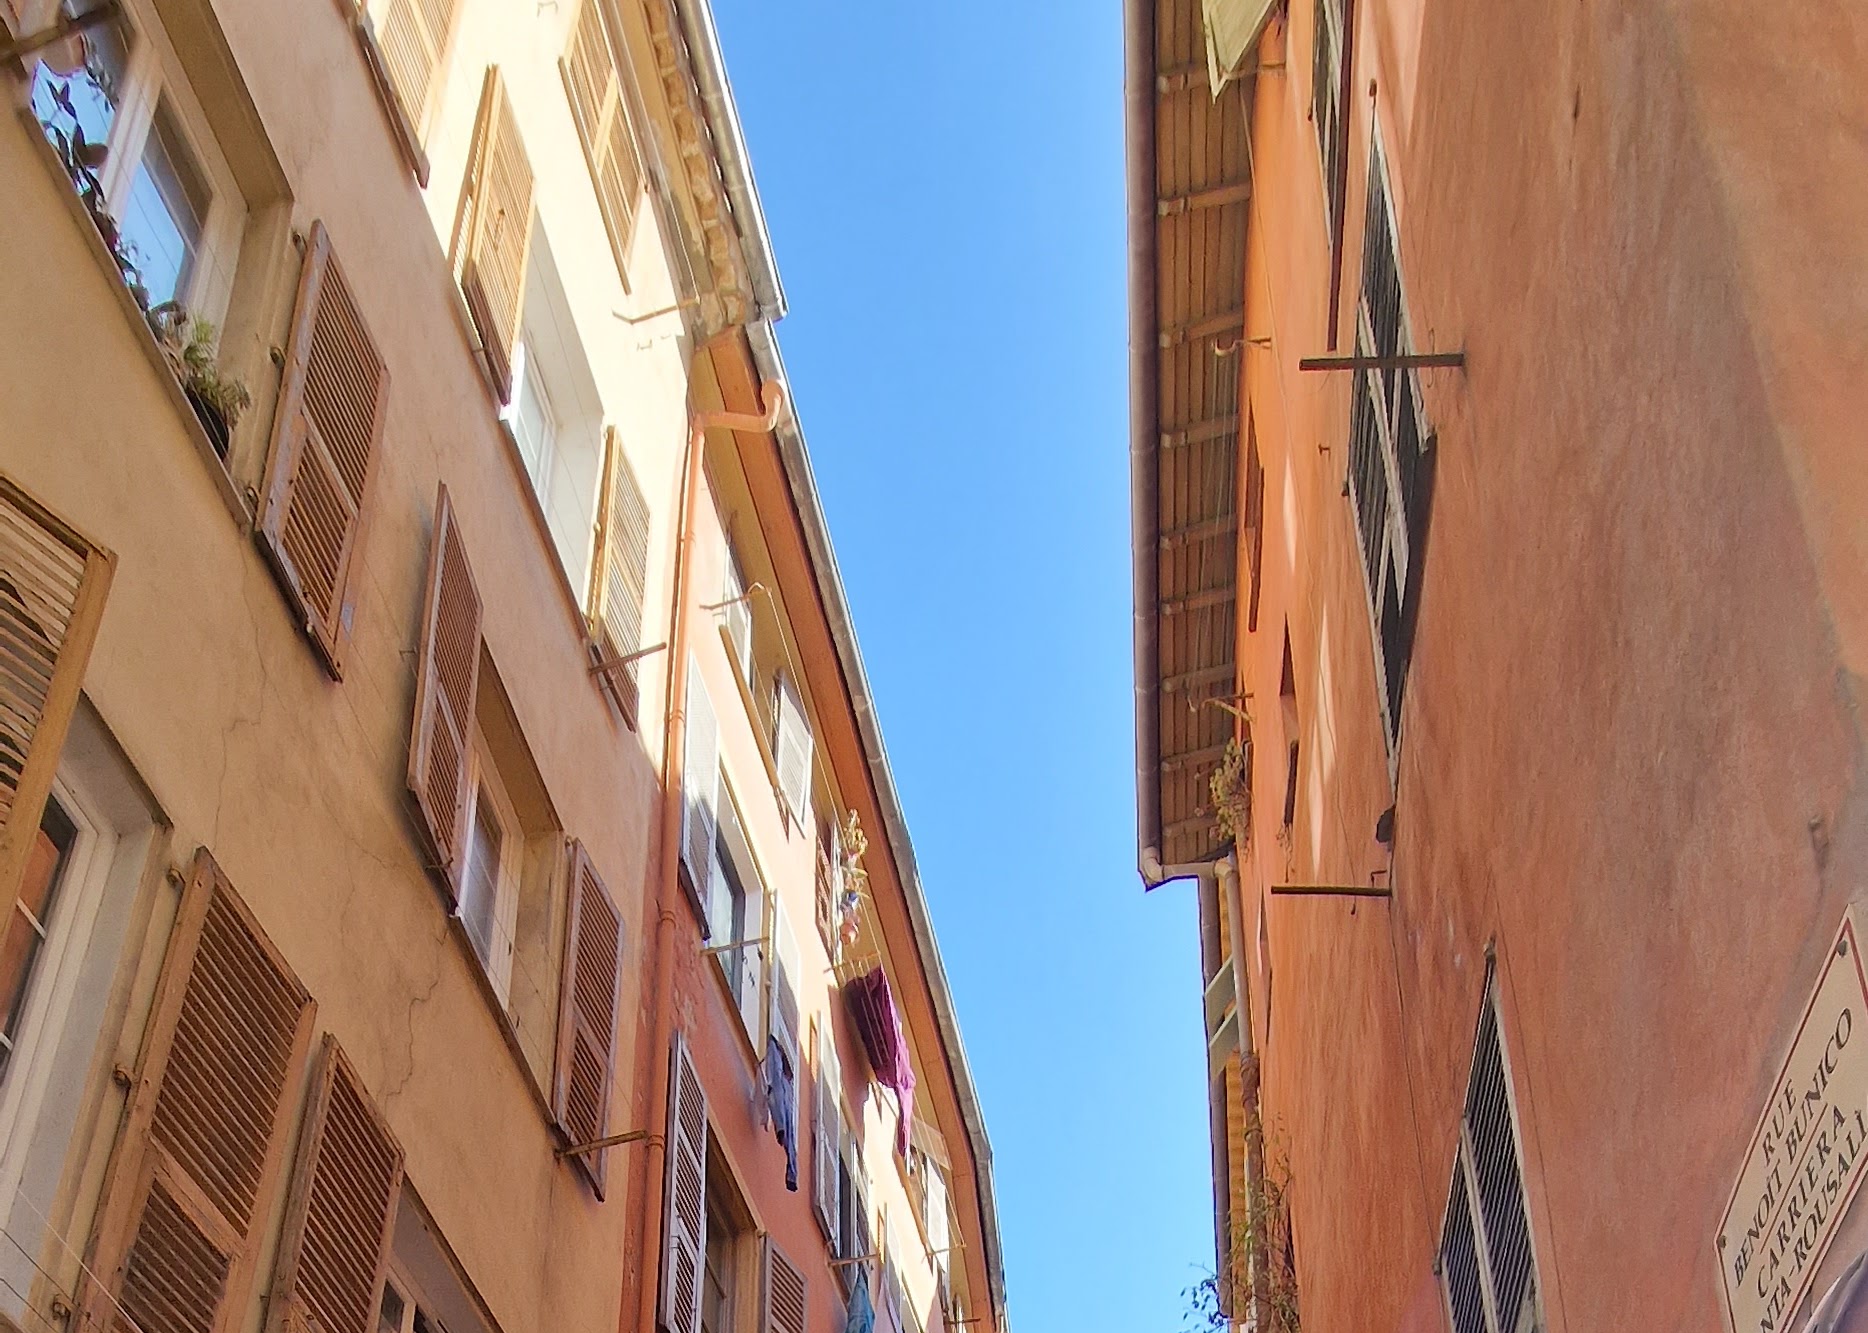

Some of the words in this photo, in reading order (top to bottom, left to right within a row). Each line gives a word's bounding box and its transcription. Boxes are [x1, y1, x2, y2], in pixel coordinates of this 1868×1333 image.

[1763, 1078, 1797, 1167] RUE
[1786, 1008, 1852, 1165] BUNICO
[1757, 1105, 1847, 1298] CARRIERA
